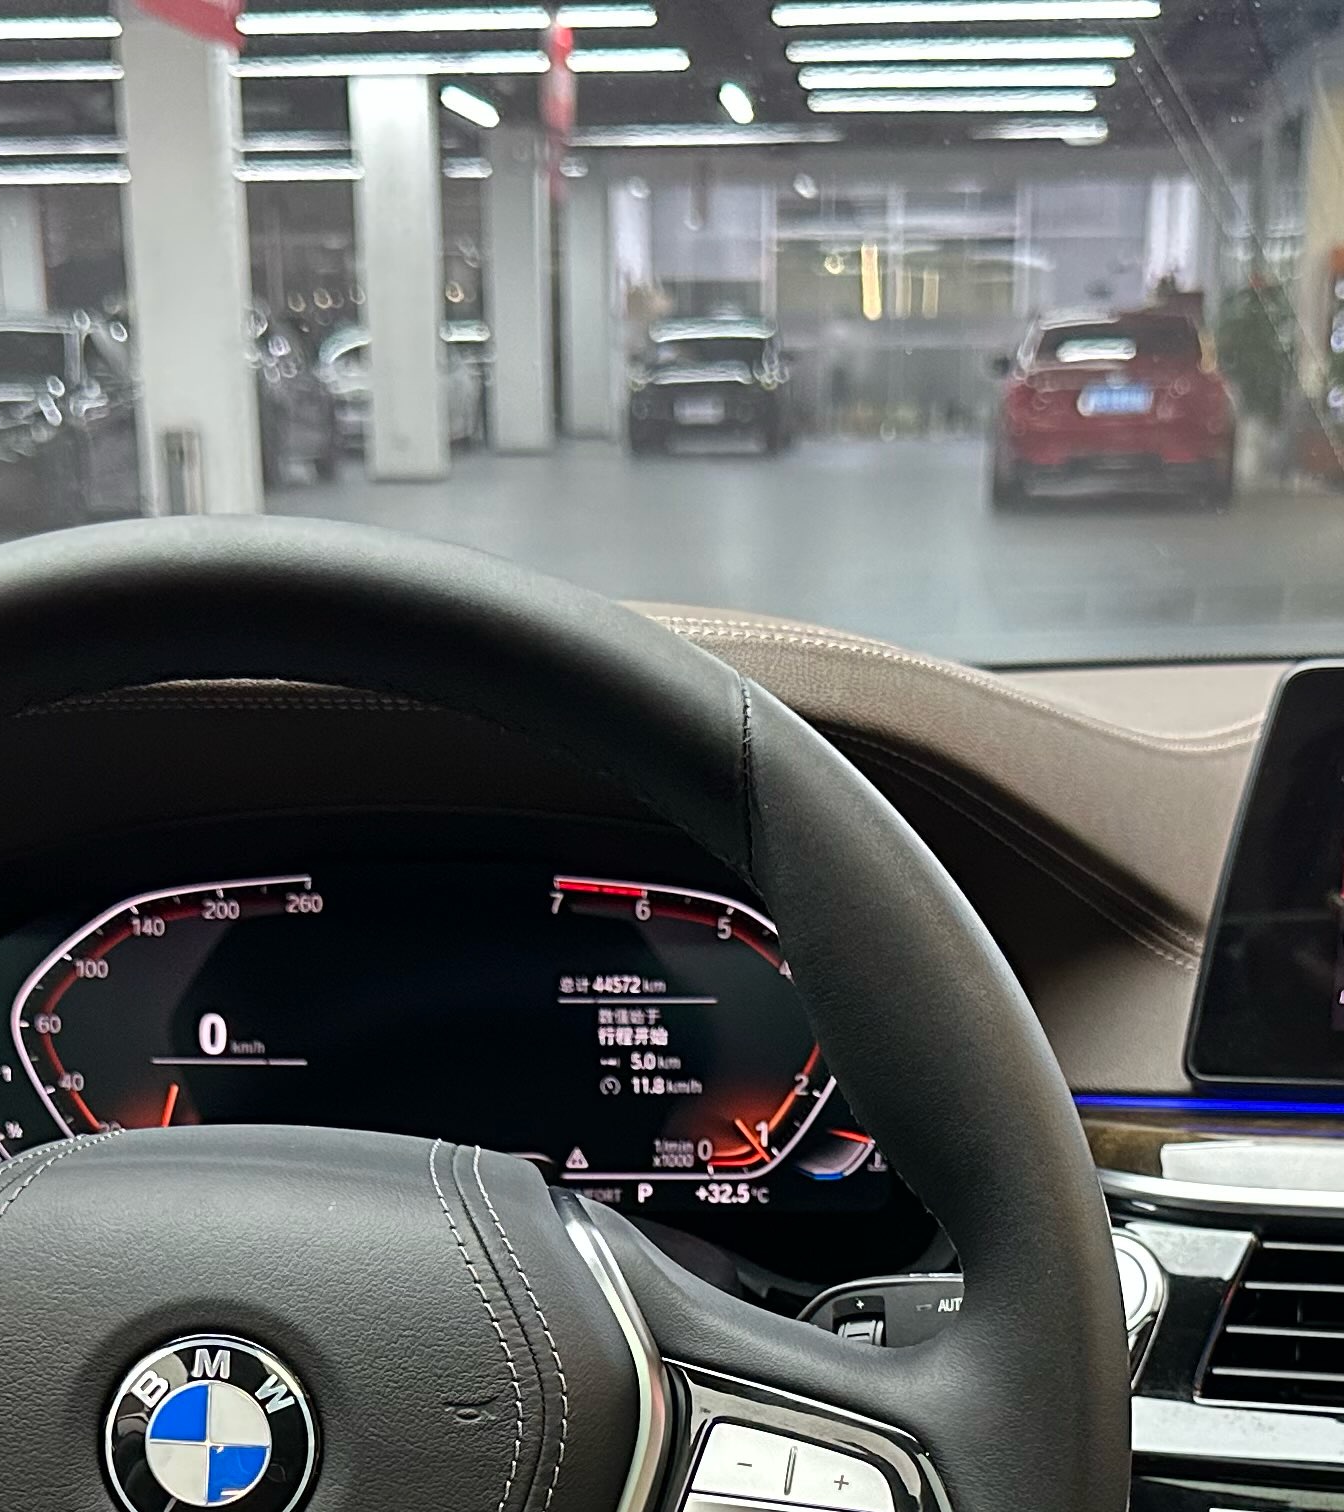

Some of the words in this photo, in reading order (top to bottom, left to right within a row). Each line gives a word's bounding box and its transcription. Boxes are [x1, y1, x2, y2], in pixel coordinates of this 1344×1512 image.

[202, 900, 240, 920] 200
[285, 893, 323, 913] 260
[550, 893, 564, 915] 7
[635, 899, 651, 921] 6
[132, 918, 165, 937] 140
[717, 917, 732, 939] 5
[75, 959, 109, 979] 100
[592, 975, 641, 993] 44572
[642, 978, 666, 993] km
[34, 1014, 62, 1034] 60
[198, 1012, 227, 1055] 0
[231, 1040, 266, 1055] km/h
[630, 1051, 656, 1070] 5.0
[657, 1056, 681, 1070] km
[58, 1071, 84, 1092] 40
[631, 1075, 665, 1095] 11.8
[666, 1079, 703, 1095] km/h
[794, 1074, 809, 1095] 2
[755, 1121, 768, 1147] 1
[697, 1138, 713, 1161] 0
[637, 1183, 654, 1203] P
[131, 1348, 296, 1414] BMW
